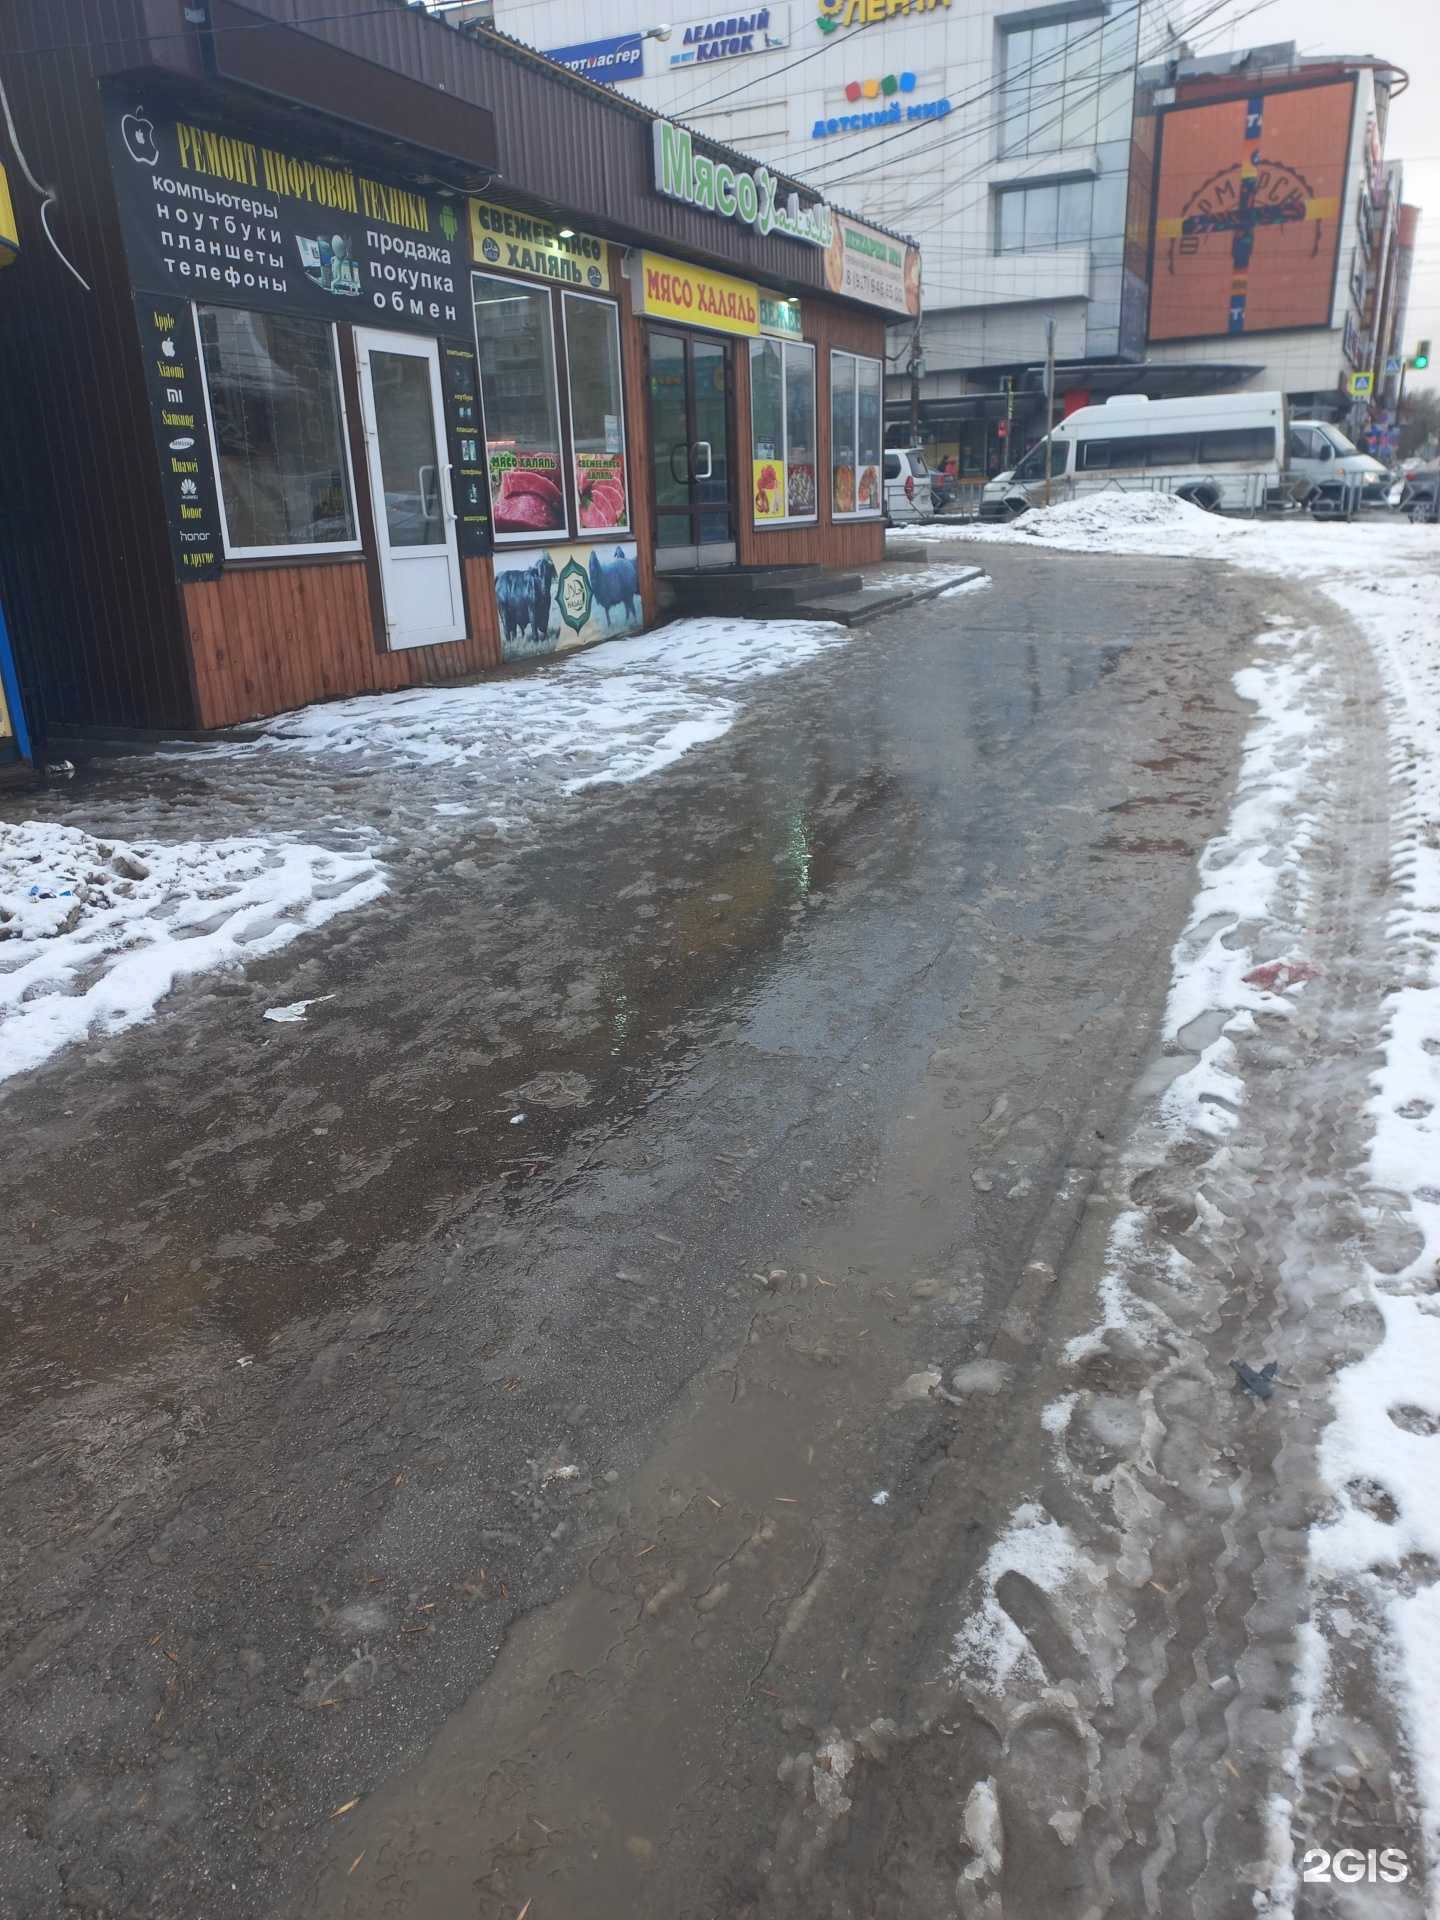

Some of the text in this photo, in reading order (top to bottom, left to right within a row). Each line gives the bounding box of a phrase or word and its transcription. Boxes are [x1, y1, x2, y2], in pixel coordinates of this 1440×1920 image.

[682, 7, 770, 46] ЛЕДОВЫЙ
[696, 34, 754, 61] КАТОК
[176, 121, 430, 233] РЕМОНТ ЦИФРОВОЙ ТЕХНИКИ
[152, 175, 279, 219] компьютеры
[156, 203, 282, 245] ноутбуки
[478, 205, 555, 249] СВЕЖЕЕ
[161, 231, 284, 269] планшеты
[366, 230, 452, 265] продажа
[507, 242, 583, 284] ХАЛЯЛЬ
[164, 258, 287, 293] телефоны
[370, 261, 454, 294] покупка
[373, 290, 457, 321] обмен
[646, 267, 693, 309] МЯСО
[696, 282, 757, 325] ХАЛЯЛЬ
[153, 311, 176, 333] Apple
[156, 360, 185, 380] Xiaomi
[161, 408, 195, 430] Samsung
[171, 457, 199, 473] Huawei
[180, 504, 202, 520] Honor
[179, 530, 211, 542] honor
